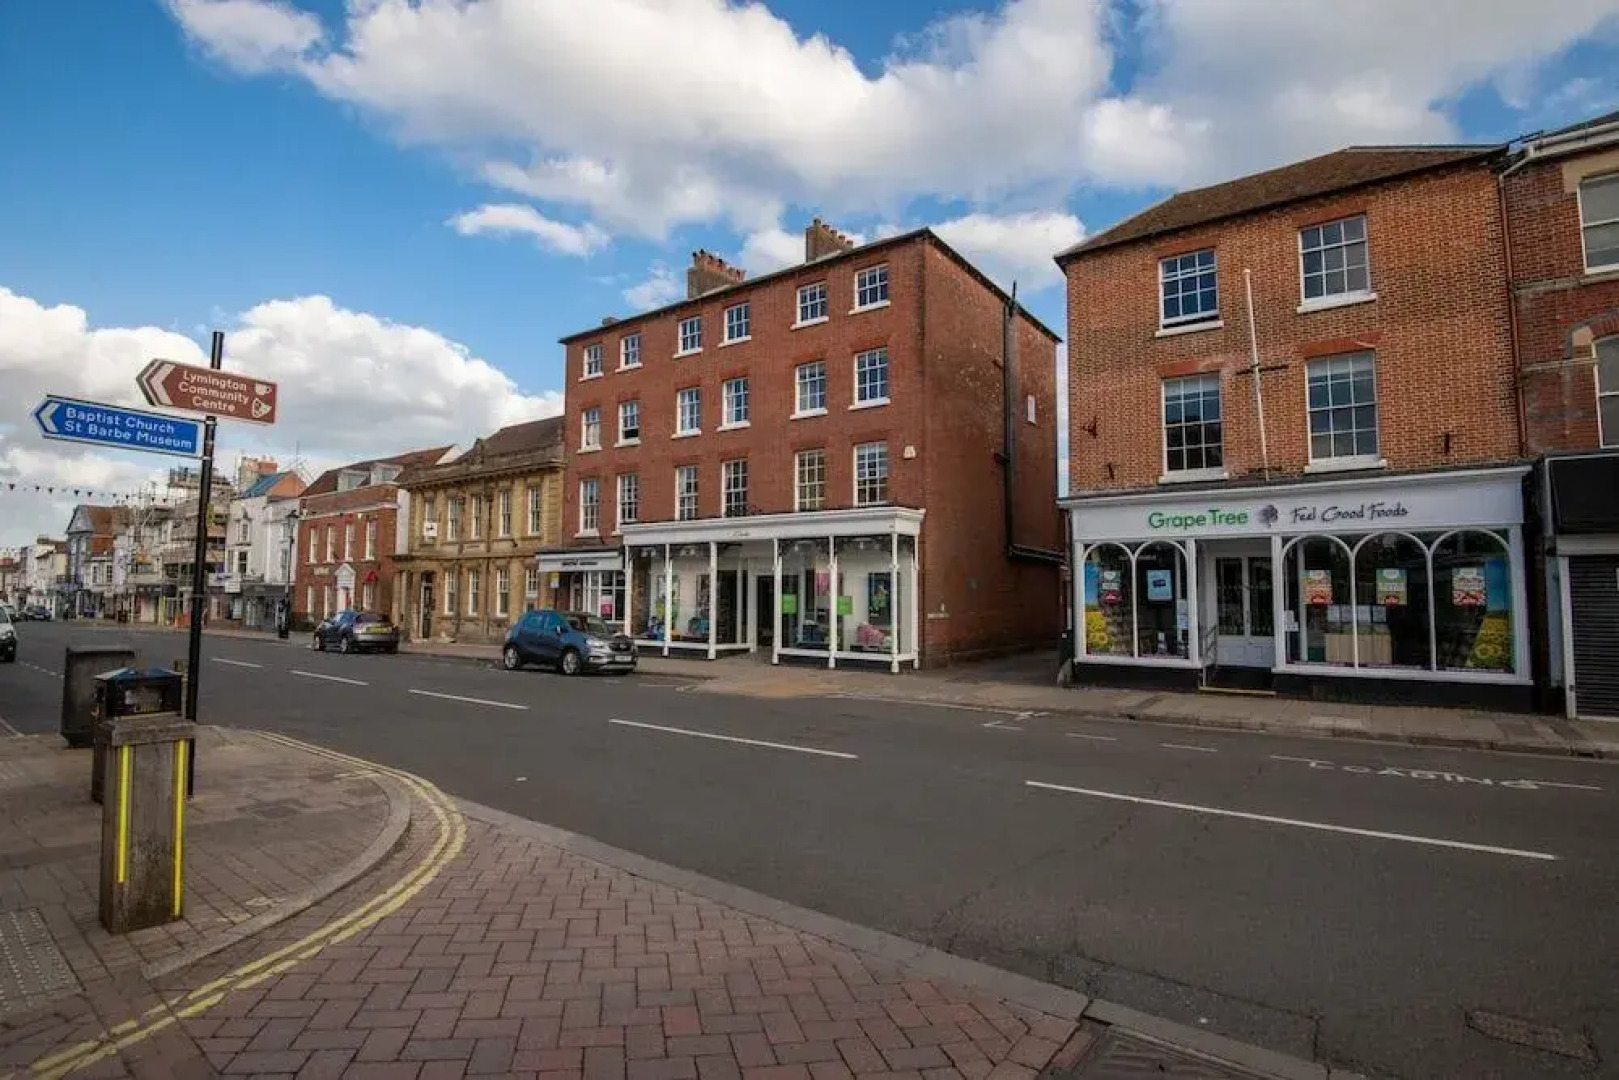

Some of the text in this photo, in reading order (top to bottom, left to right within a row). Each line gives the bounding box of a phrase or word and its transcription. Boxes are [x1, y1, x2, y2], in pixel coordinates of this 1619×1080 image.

[183, 370, 248, 392] Lymington
[178, 381, 250, 404] Community
[192, 396, 236, 413] Centre
[66, 407, 175, 433] Baptist Church
[64, 420, 192, 449] St Barbe Museum
[1321, 505, 1365, 523] Good
[1367, 502, 1408, 520] Foods
